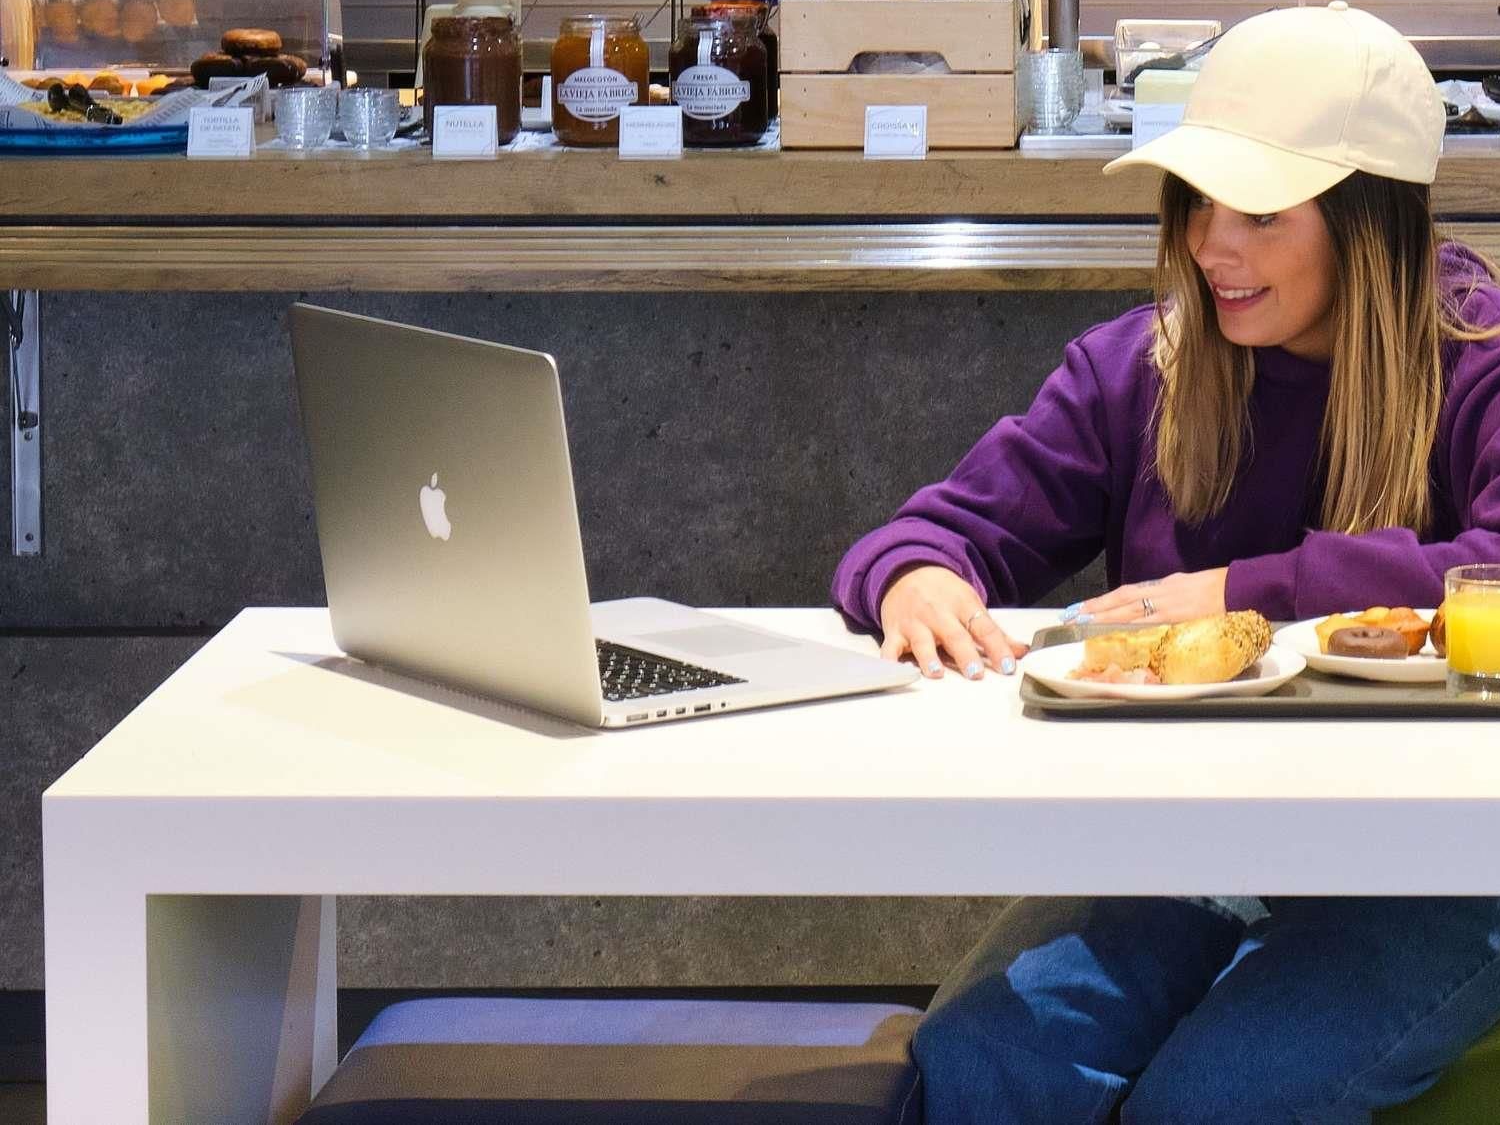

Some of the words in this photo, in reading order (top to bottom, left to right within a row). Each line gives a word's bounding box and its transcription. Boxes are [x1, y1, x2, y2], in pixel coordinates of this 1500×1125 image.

[597, 86, 635, 99] FÁBRICA
[707, 85, 746, 96] FÁBRICA
[446, 120, 484, 128] NUTELLA
